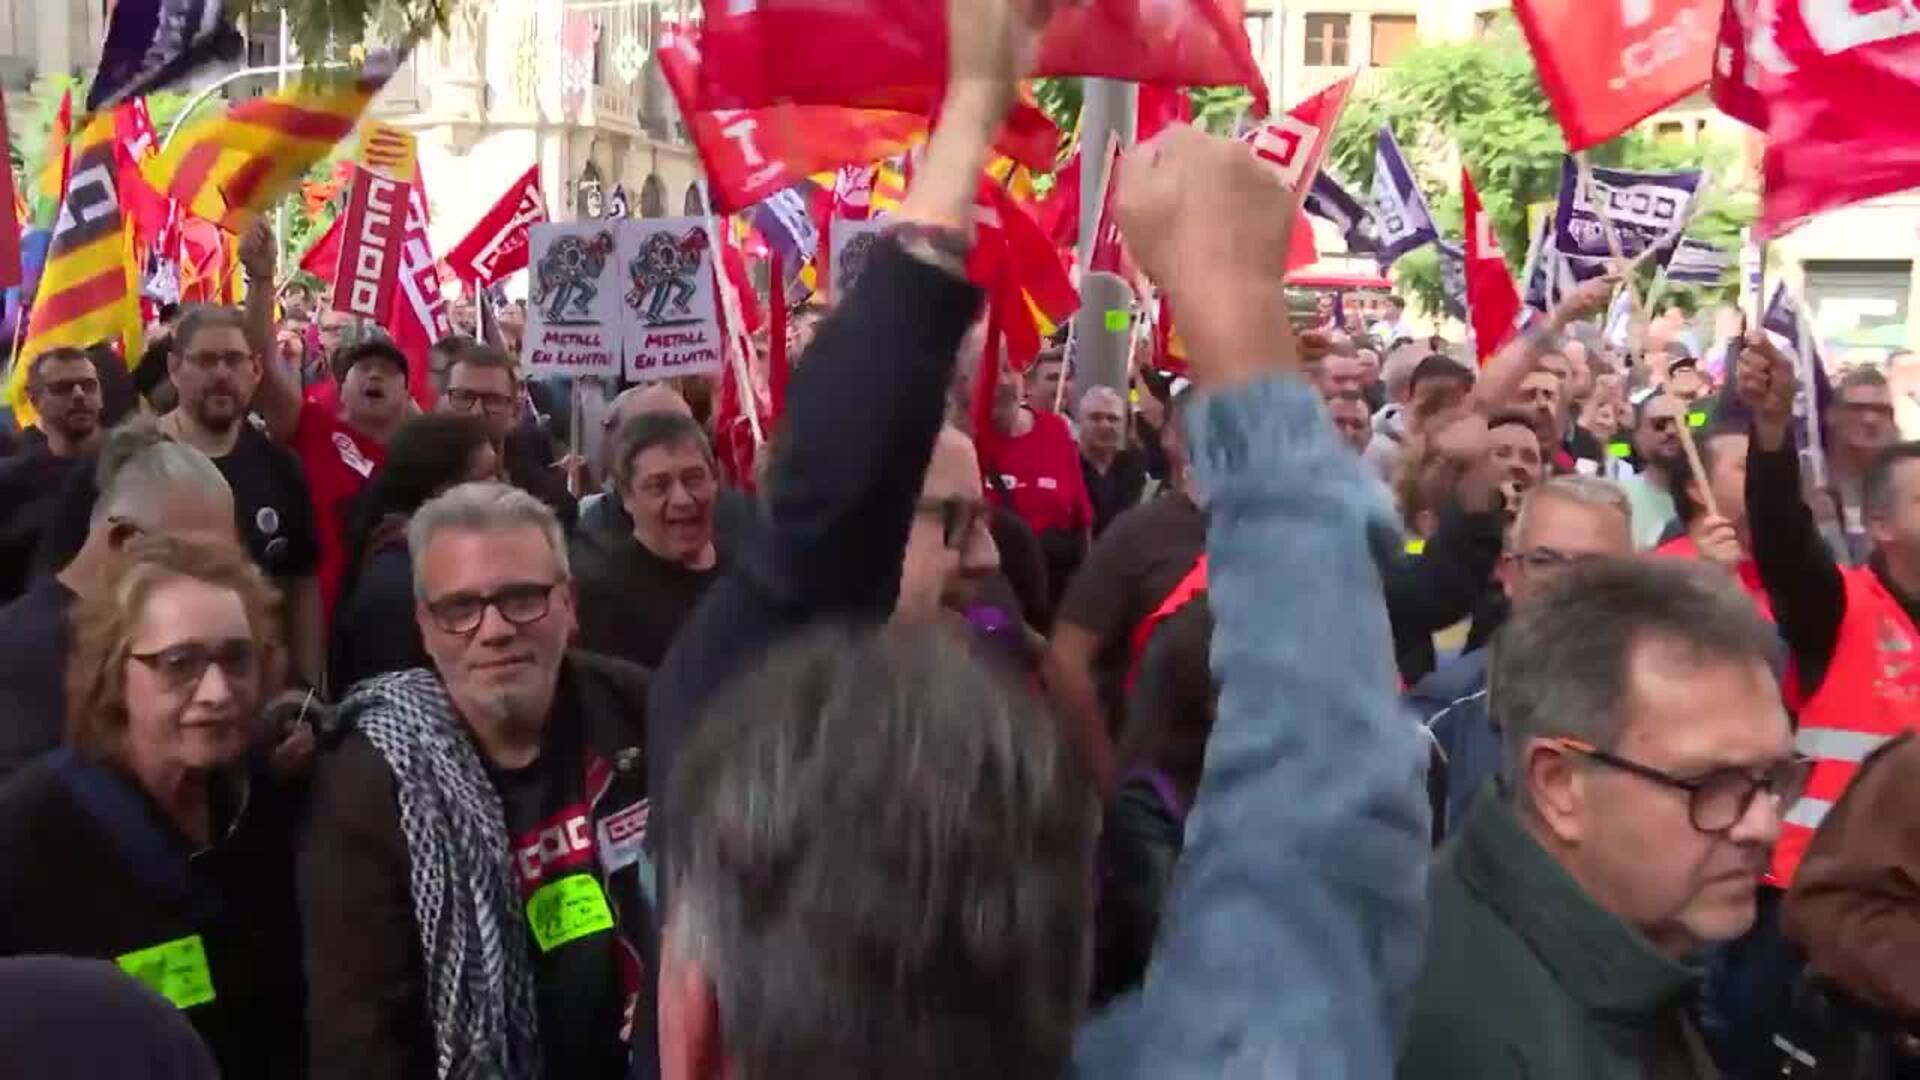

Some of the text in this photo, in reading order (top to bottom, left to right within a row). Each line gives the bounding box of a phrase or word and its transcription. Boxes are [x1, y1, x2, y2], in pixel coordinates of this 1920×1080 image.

[351, 178, 396, 313] CCOO
[544, 332, 600, 346] METALL
[645, 331, 707, 348] METALL
[532, 350, 552, 364] EN
[635, 354, 656, 369] EN
